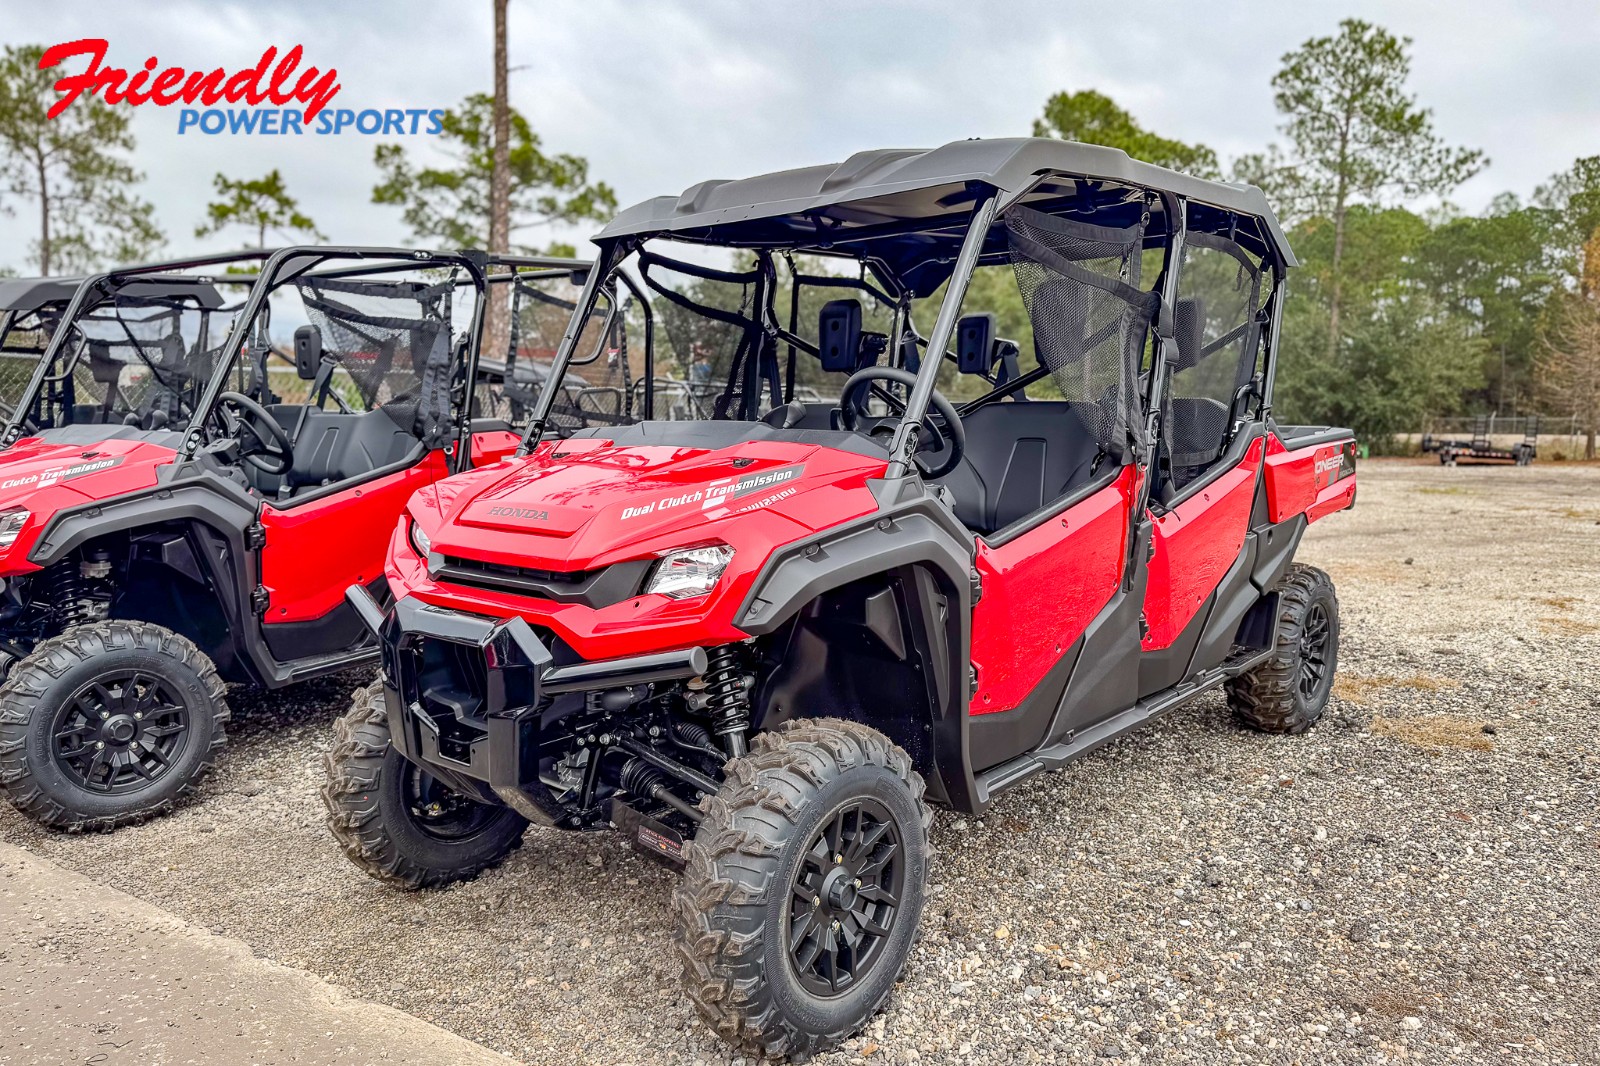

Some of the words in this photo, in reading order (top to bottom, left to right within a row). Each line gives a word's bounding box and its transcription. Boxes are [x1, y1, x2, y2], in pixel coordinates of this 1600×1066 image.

[1, 474, 39, 490] Clutch
[40, 459, 115, 481] Transmission
[620, 501, 656, 520] Dual
[657, 490, 703, 511] Clutch
[705, 470, 793, 499] Transmission
[487, 506, 549, 521] HONDA
